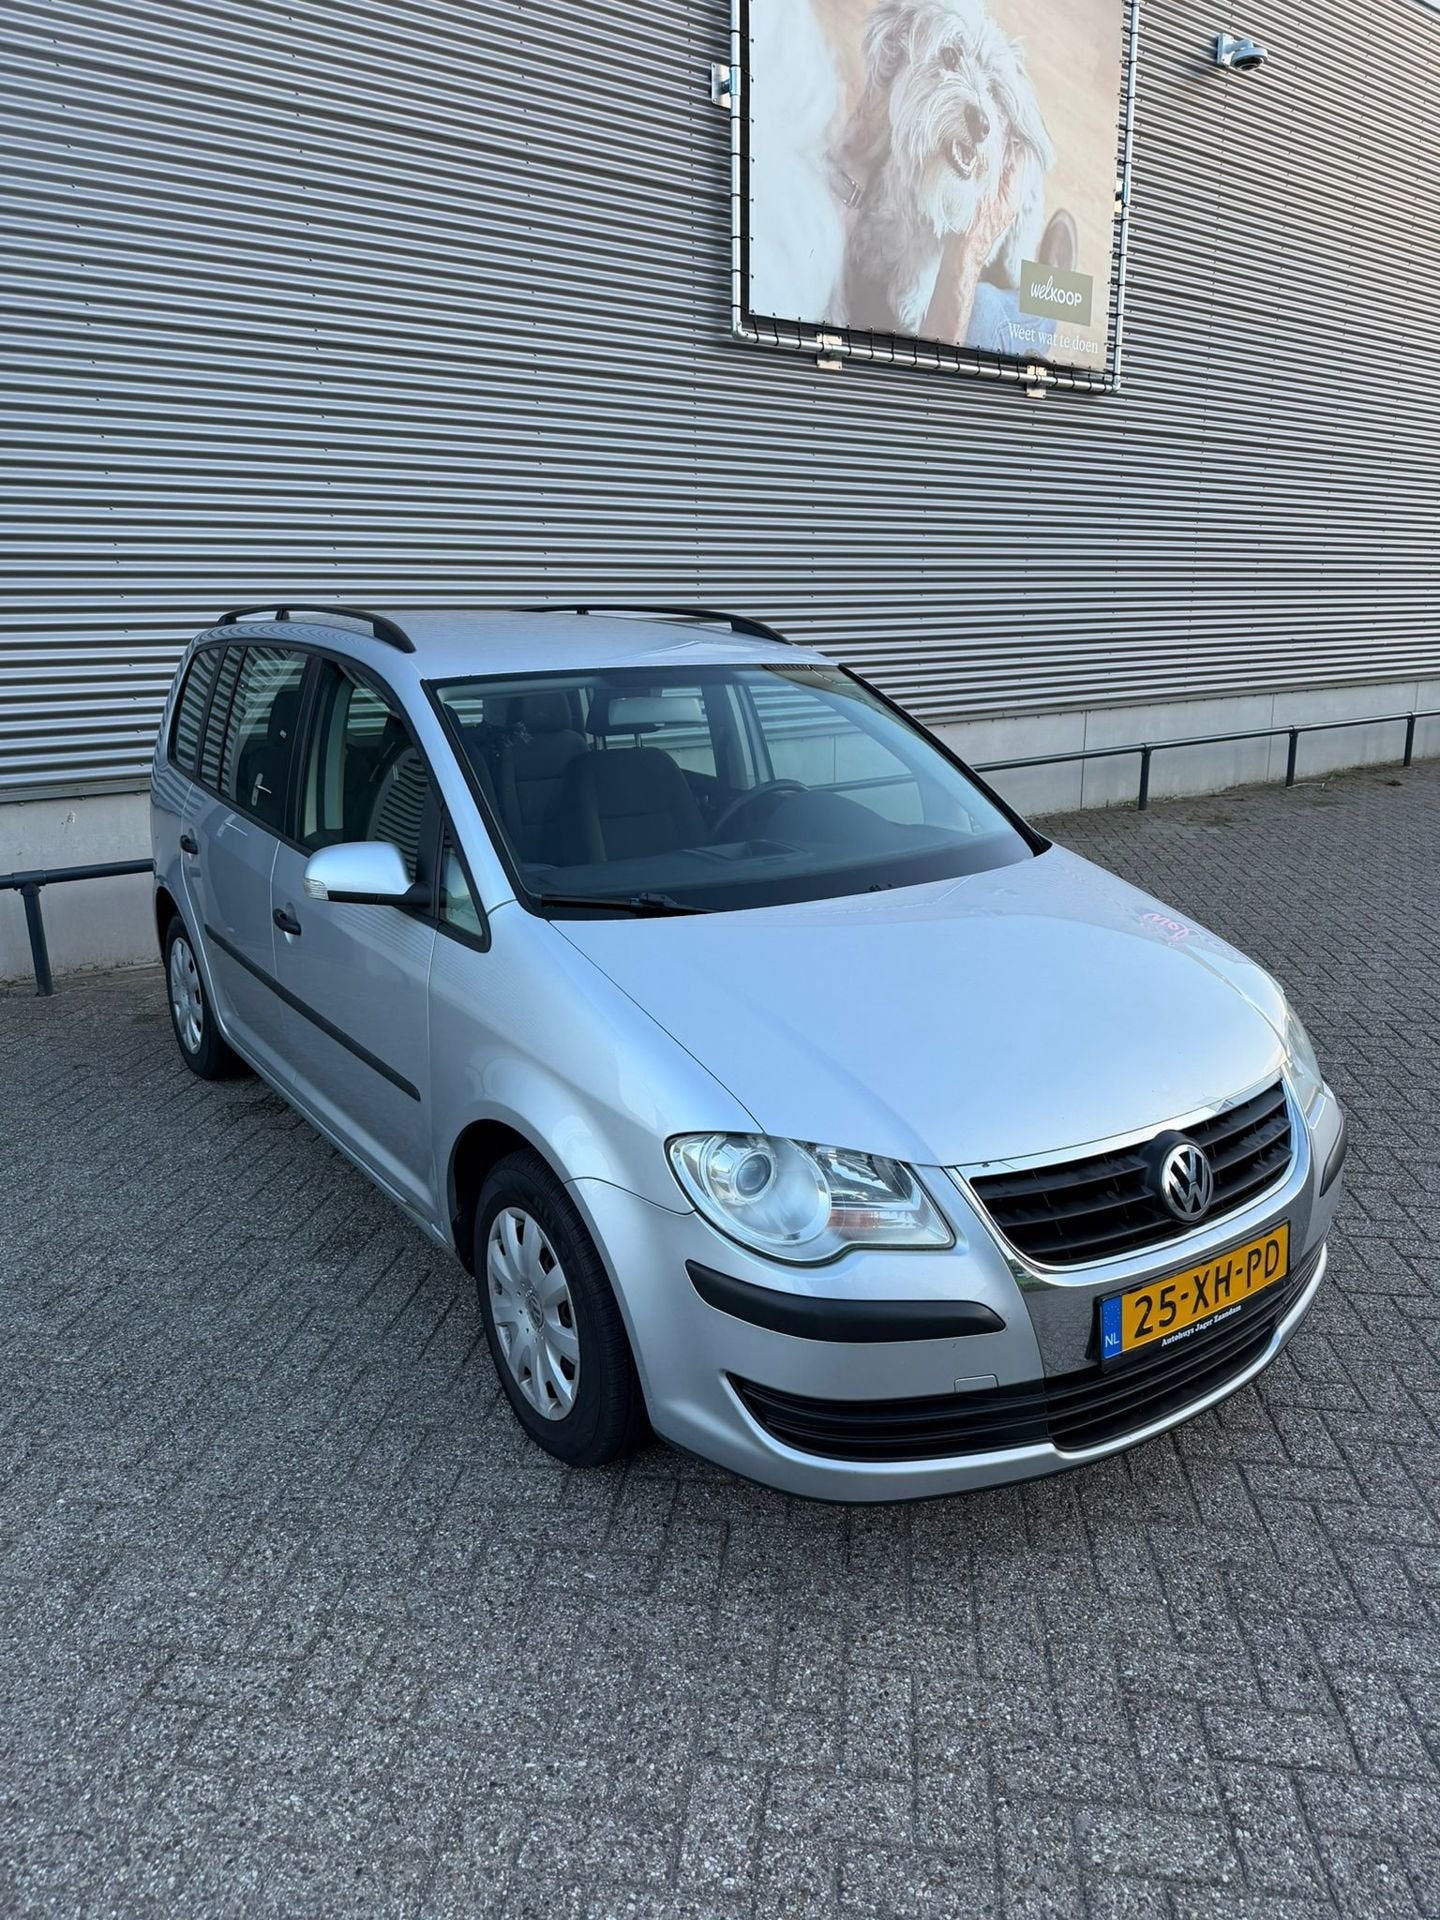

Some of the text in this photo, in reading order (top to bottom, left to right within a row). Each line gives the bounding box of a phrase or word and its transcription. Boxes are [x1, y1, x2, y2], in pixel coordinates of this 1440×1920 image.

[1008, 322, 1098, 353] Weet wat te doen
[1162, 1144, 1213, 1221] VW
[1134, 1239, 1280, 1339] 25-XH-PD
[1104, 1332, 1120, 1348] NL
[1161, 1305, 1242, 1347] Autohuys Jager Zaandam
